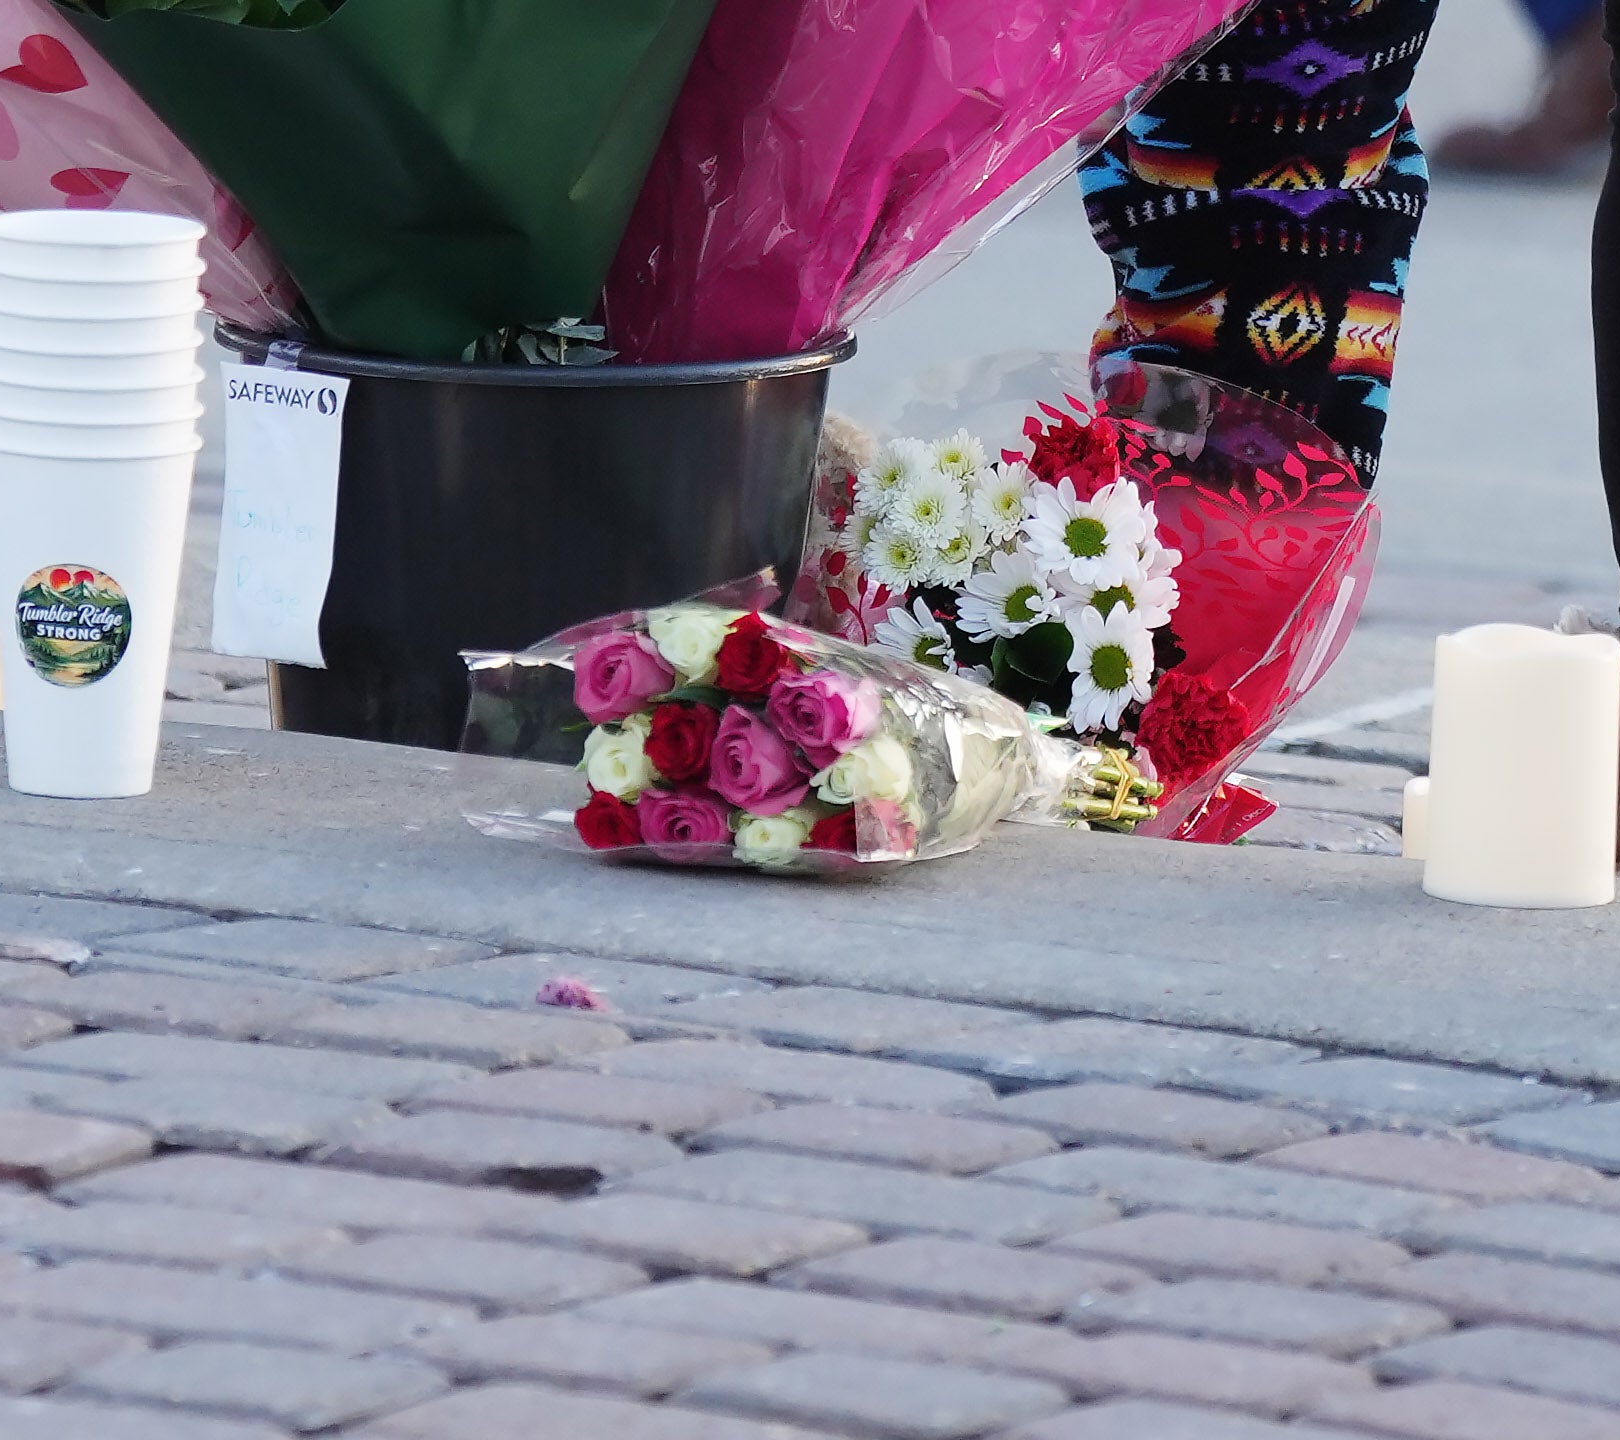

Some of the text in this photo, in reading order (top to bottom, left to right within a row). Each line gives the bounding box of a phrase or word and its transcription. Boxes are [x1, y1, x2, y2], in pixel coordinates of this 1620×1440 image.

[228, 379, 315, 410] SAFEWAY
[19, 602, 123, 632] Tumbler Ridge
[36, 623, 102, 640] STRONG
